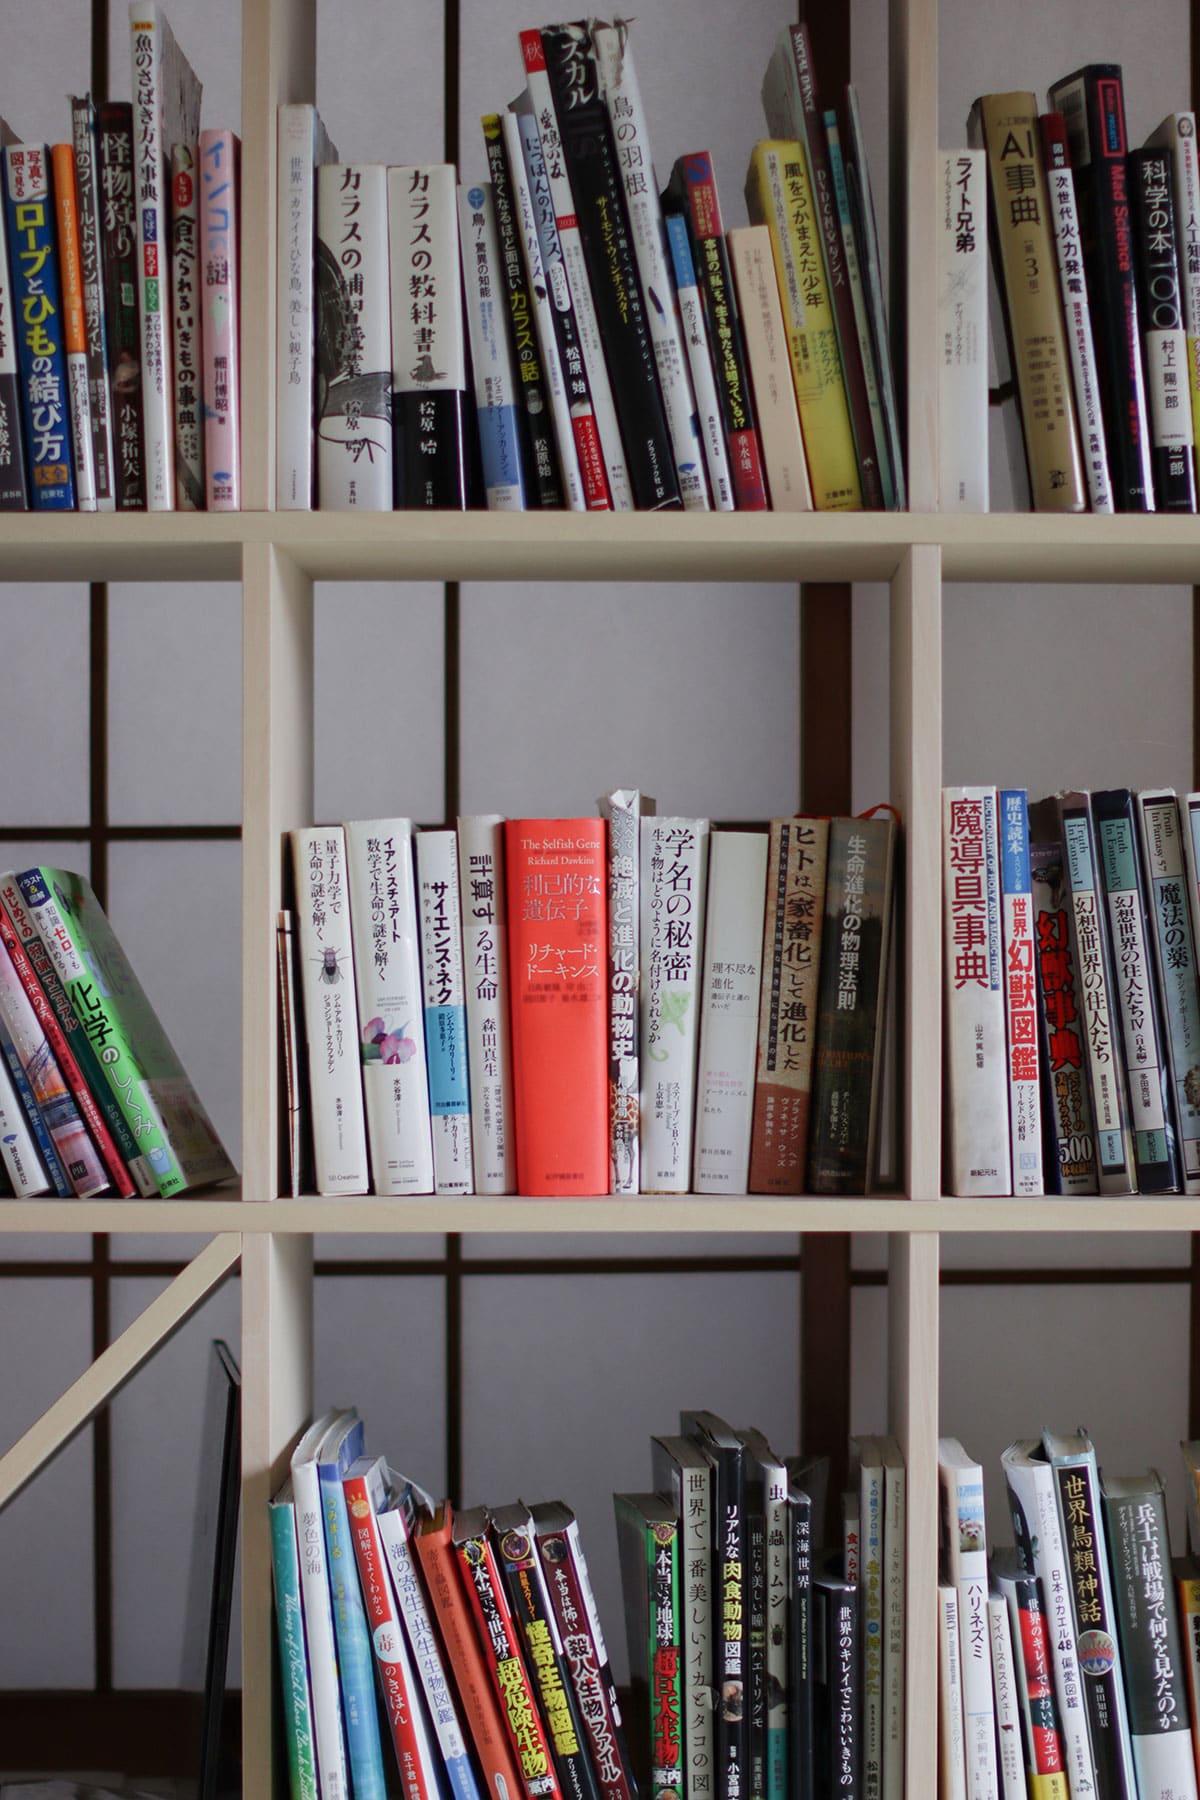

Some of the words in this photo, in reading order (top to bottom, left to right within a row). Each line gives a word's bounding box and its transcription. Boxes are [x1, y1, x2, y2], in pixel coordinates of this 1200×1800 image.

[526, 43, 544, 60] 秋
[560, 41, 594, 110] スカル
[794, 32, 808, 70] SOCIAL
[801, 75, 815, 112] DANCE
[135, 33, 158, 202] 魚のさばき方大事典
[612, 96, 648, 197] 鳥の羽根
[102, 132, 134, 258] 怪物狩り
[526, 137, 562, 262] にっぽんのカラス
[956, 158, 976, 255] ライト兄弟
[1000, 129, 1041, 228] AI事典
[1111, 166, 1127, 204] Mad
[338, 167, 367, 379] カラスの補習授業
[409, 170, 437, 353] カラスの教科書
[488, 145, 540, 383] 眠れなくなるほど面白いカラスの話
[596, 196, 629, 325] サイモン・ウィンチェスター
[784, 161, 824, 309] 風をつかまえた少年
[1055, 175, 1083, 294] 次世代火力発電
[1115, 207, 1132, 272] Science
[15, 203, 64, 462] ロープとひもの結び方
[174, 214, 197, 430] 食べられるいきものの事典
[566, 346, 583, 375] 松原
[1161, 340, 1176, 368] 村上
[213, 356, 229, 412] 細川博昭
[345, 400, 361, 431] 松原
[419, 401, 436, 432] 松原
[572, 379, 586, 394] 始
[1163, 372, 1180, 409] 陽一郎
[35, 465, 68, 485] 大全
[120, 404, 140, 478] 小塚拓矢
[420, 440, 438, 455] 始
[535, 438, 552, 478] 松原始
[521, 839, 540, 850] The
[542, 838, 574, 855] Selfish
[576, 839, 600, 850] Gene
[527, 856, 559, 866] Richard
[561, 856, 595, 866] Dawkins
[984, 797, 994, 853] DICTIONARY
[1006, 797, 1023, 856] 歴史読本
[1069, 835, 1083, 879] Fantasy
[1076, 821, 1089, 855] Truth
[1106, 835, 1119, 877] Fantasy
[1115, 822, 1126, 855] Truth
[1152, 823, 1166, 860] Fantasy
[1162, 808, 1172, 838] Truth
[2, 886, 33, 938] はじめての
[30, 884, 38, 895] &
[309, 840, 328, 941] 生命の謎を解く
[326, 840, 342, 915] 量子力学で
[367, 838, 389, 982] 数学で生命の謎を解く
[384, 837, 401, 943] イアン・スチュアート
[522, 899, 590, 922] 遺伝子
[523, 873, 601, 896] 利己的な
[662, 828, 695, 983] 学名の秘密
[949, 797, 989, 991] 魔導具事典
[469, 854, 498, 1001] 計算する生命
[528, 943, 598, 962] リチャード・
[611, 855, 635, 1061] 絶滅と進化の動物史
[648, 828, 665, 1044] 生き物はどのように名付けられるか
[779, 825, 816, 1071] ヒトは〈家畜化〉して進化した
[836, 835, 867, 1011] 生命進化の物理法則
[1114, 895, 1144, 1031] 幻想世界の住人たちIV
[1159, 883, 1189, 970] 魔法の薬
[28, 942, 79, 1031] 狩猟マニュアル
[527, 963, 600, 981] ドーキンス
[711, 962, 757, 975] 理不尽な
[711, 977, 735, 990] 進化
[1008, 897, 1037, 1081] 世界幻獣図鑑
[1075, 895, 1110, 1065] 幻想世界の住人たち
[70, 981, 155, 1138] 化学のしくみ
[482, 1018, 498, 1077] 森田真生
[1058, 1135, 1093, 1163] 500
[302, 1511, 322, 1575] 夢色の海
[357, 1528, 384, 1615] 図解でよくわかる
[768, 1484, 786, 1608] 虫と蟲とムシ
[796, 1521, 810, 1588] 深海世界
[1064, 1474, 1102, 1623] 世界鳥類神話
[472, 1566, 509, 1659] 本当にいる世界の
[554, 1568, 579, 1631] 本当は怖い
[656, 1550, 674, 1648] 本当にいる地球の
[722, 1504, 743, 1676] リアルな肉食動物図鑑
[946, 1602, 957, 1631] DARCY
[967, 1584, 985, 1659] ハリネズミ
[1051, 1569, 1073, 1651] 日本のカエル48
[1135, 1502, 1178, 1730] 兵士は戦場で何を見たのか
[391, 1544, 454, 1725] 海の寄生・共生生物図鑑
[687, 1474, 709, 1793] 世界で一番美しいイカとタコの図
[379, 1633, 408, 1726] 毒のきほん
[526, 1619, 580, 1756] 怪奇生物図鑑
[563, 1634, 622, 1783] 殺人生物ファイル
[751, 1651, 764, 1728] ハエトリグモ
[839, 1606, 854, 1785] 世界のキレイでこわいいきもの
[1027, 1598, 1058, 1767] 世界のキレイでかわいいカエル
[527, 1777, 557, 1796] 案内
[653, 1769, 681, 1785] 案内
